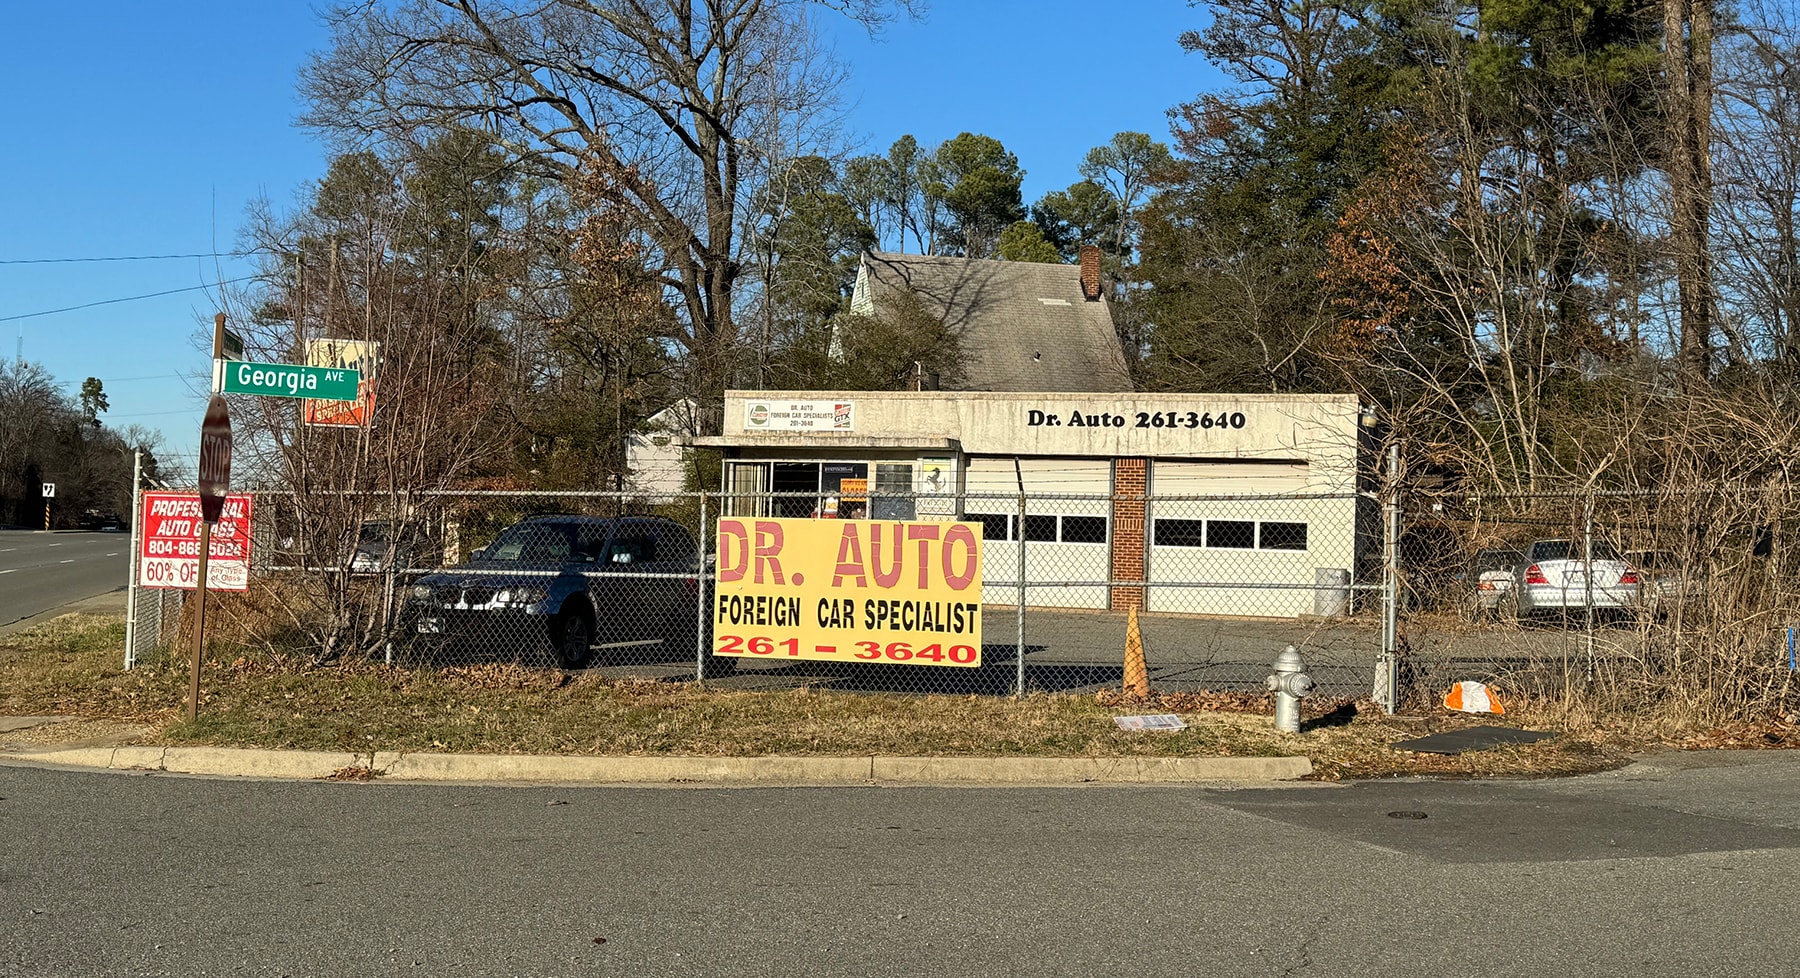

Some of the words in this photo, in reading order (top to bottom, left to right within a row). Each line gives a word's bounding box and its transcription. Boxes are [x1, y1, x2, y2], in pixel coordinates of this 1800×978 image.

[238, 364, 317, 395] Georgia
[325, 371, 345, 382] AVE
[834, 412, 850, 422] GTX
[1028, 410, 1061, 427] Dr.
[1067, 410, 1126, 427] Auto
[1135, 411, 1246, 429] 261-3640
[201, 433, 230, 482] STOP
[150, 500, 243, 518] PROFESNAL
[156, 520, 191, 537] AUTO
[193, 520, 237, 538] GASS
[149, 541, 242, 557] 804-8685024
[720, 520, 804, 586] DR.
[832, 523, 977, 590] AUTO
[147, 561, 174, 582] 60%
[180, 563, 199, 582] OF
[210, 566, 223, 574] Any
[227, 566, 242, 574] Type
[719, 595, 800, 626] FOREIGN
[817, 598, 855, 629] CAR
[864, 600, 978, 633] SPECIALIST
[718, 635, 799, 656] 261
[854, 641, 977, 663] 3640
